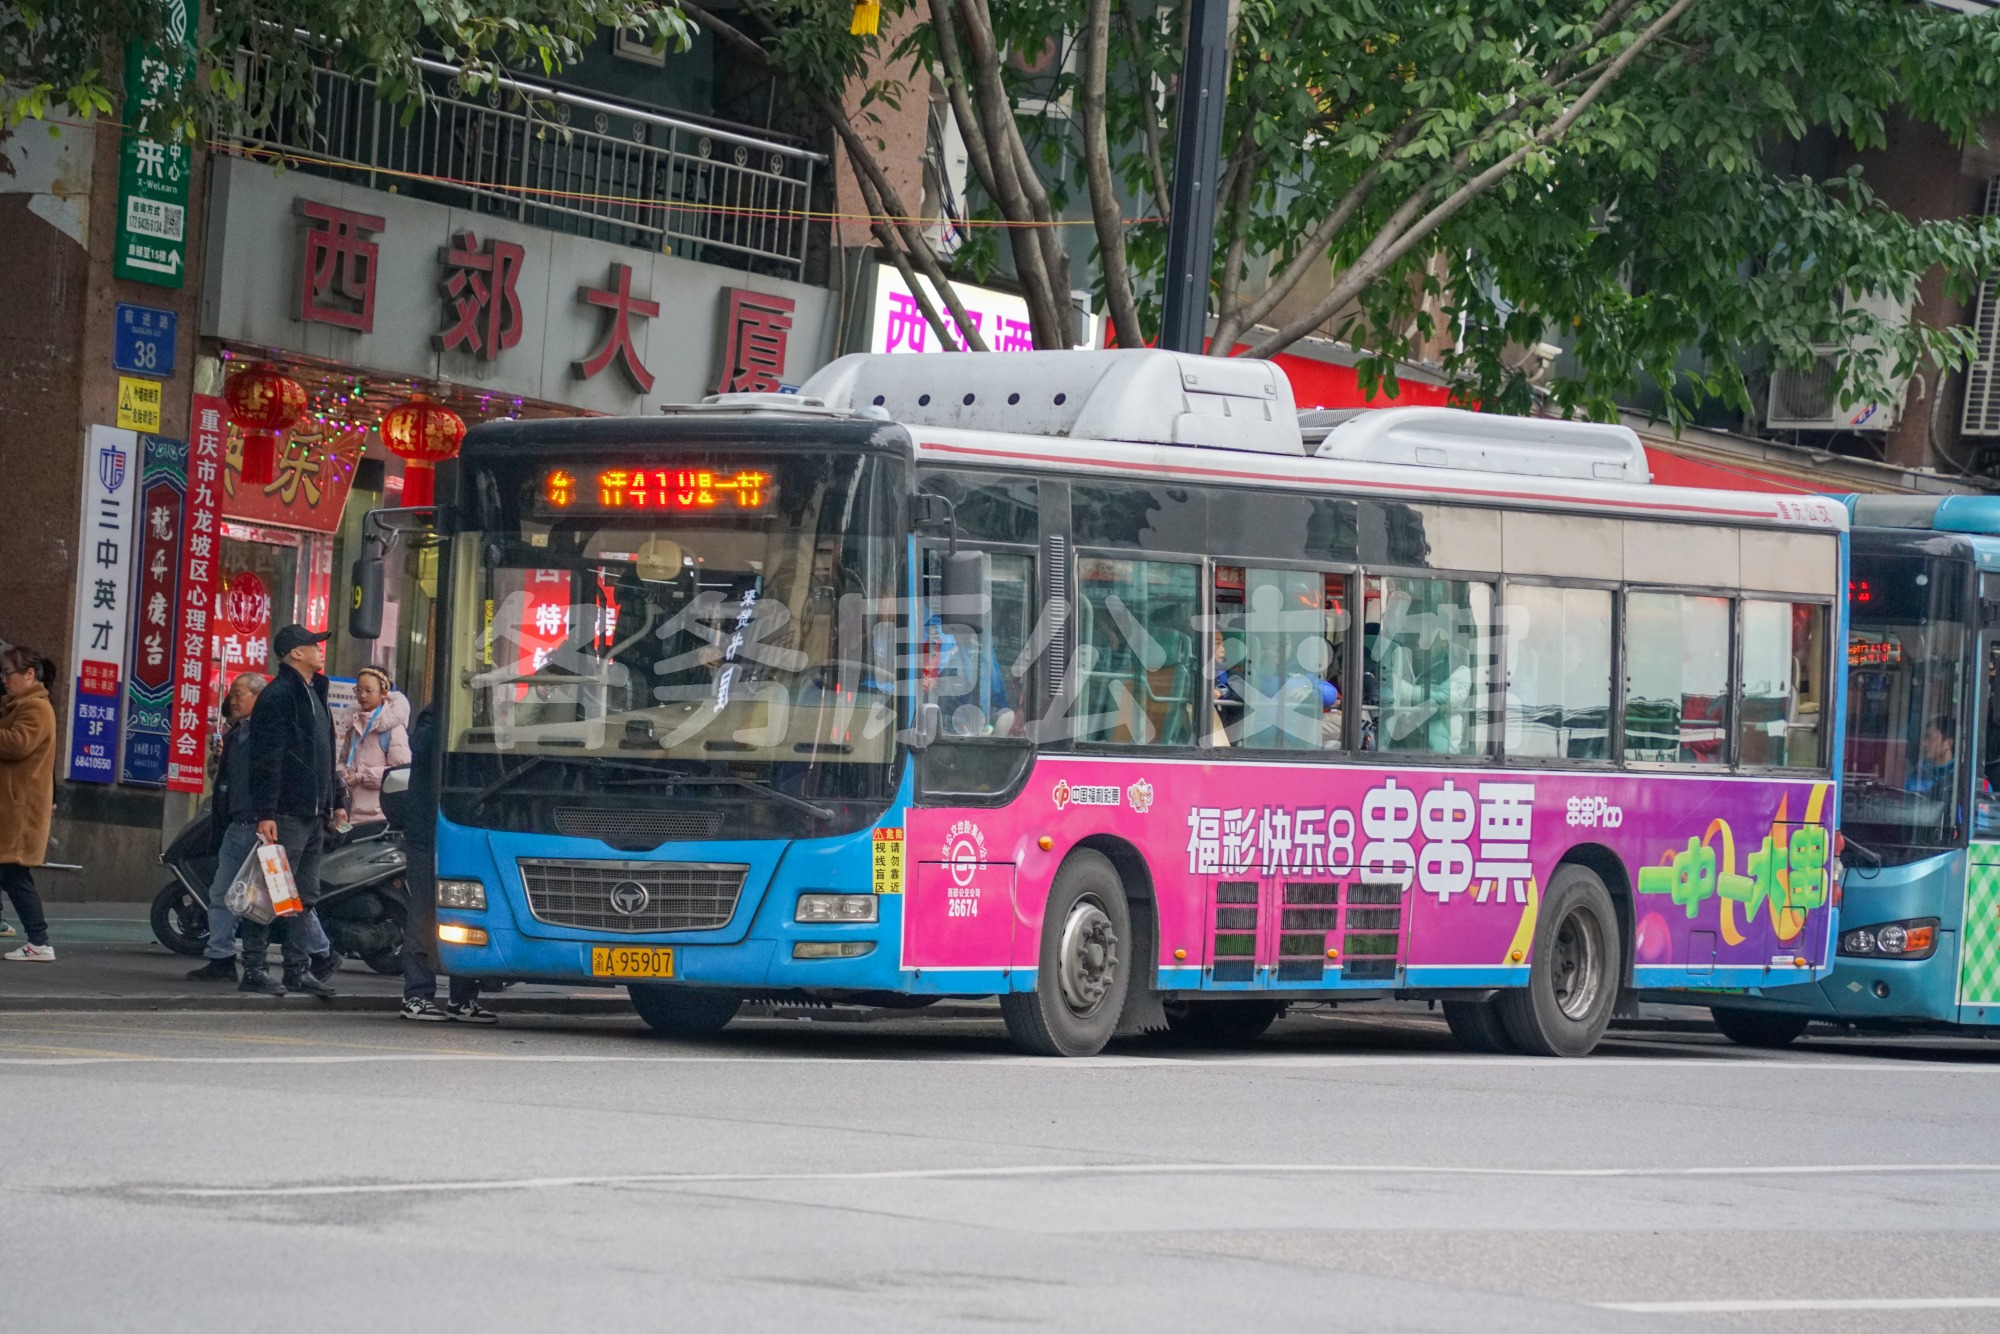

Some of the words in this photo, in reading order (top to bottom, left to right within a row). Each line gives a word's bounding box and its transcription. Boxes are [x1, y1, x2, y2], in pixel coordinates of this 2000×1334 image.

[136, 177, 178, 194] X-WeLearn
[293, 196, 796, 394] 西郊大厦
[133, 340, 157, 369] 38
[1776, 501, 1833, 523] 重庆公交
[91, 499, 120, 651] 三中英才
[176, 408, 221, 757] 重庆市九龙坡区心理咨询师协会
[79, 703, 116, 721] 西郊大厦
[88, 721, 104, 736] 3F
[89, 745, 105, 757] 023
[74, 755, 112, 770] 68410550
[1072, 786, 1120, 804] 中国福利彩票
[886, 829, 903, 840] 危险
[947, 887, 981, 898] 西部公交公司
[948, 898, 978, 917] 26674
